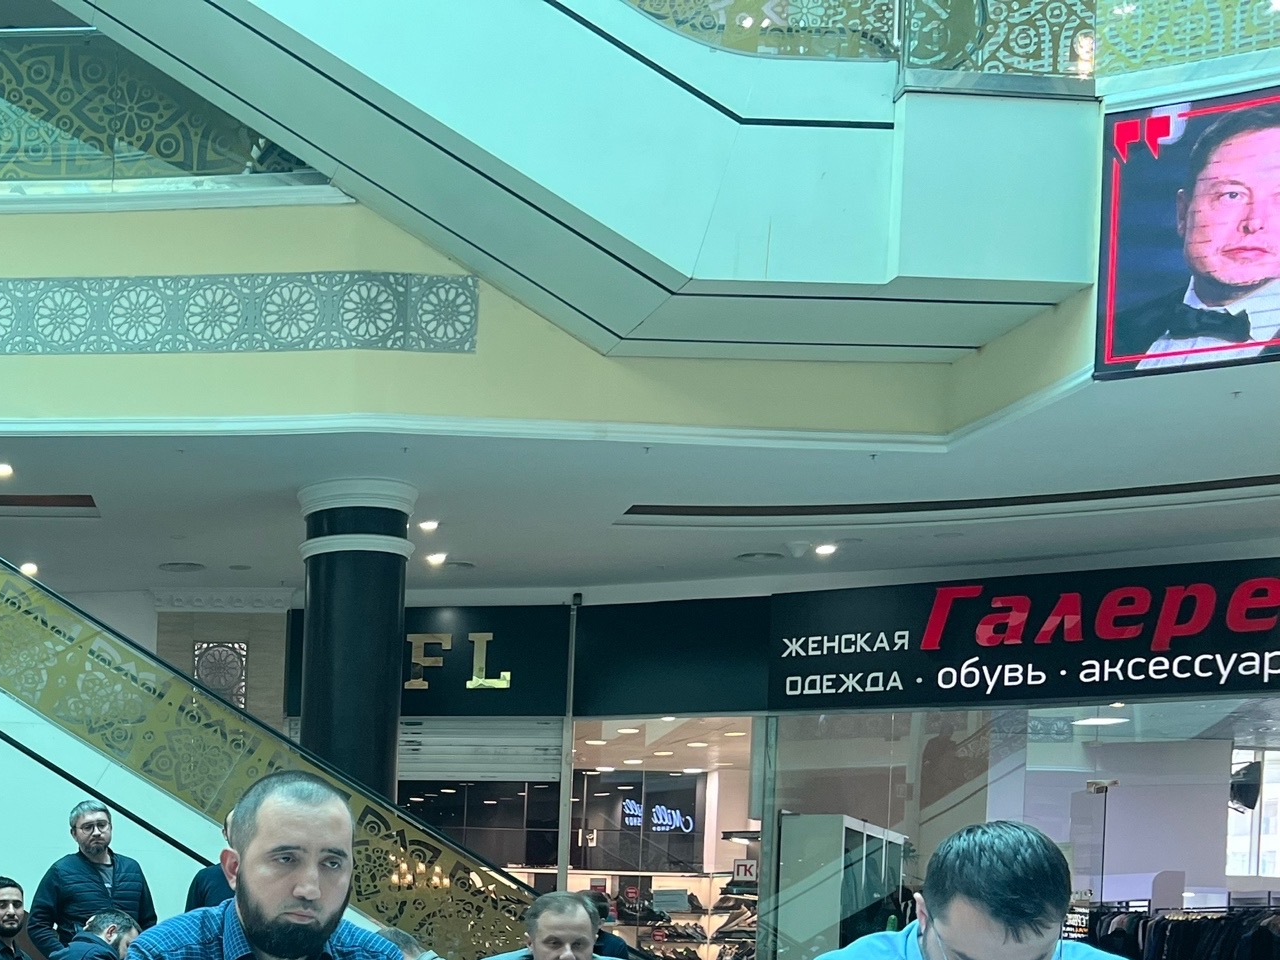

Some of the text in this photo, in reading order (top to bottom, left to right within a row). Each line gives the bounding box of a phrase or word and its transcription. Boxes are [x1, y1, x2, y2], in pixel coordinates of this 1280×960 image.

[781, 630, 910, 657] ЖЕНСКАЯ
[785, 670, 904, 696] ОДЕЖДА
[937, 656, 1047, 695] обувь
